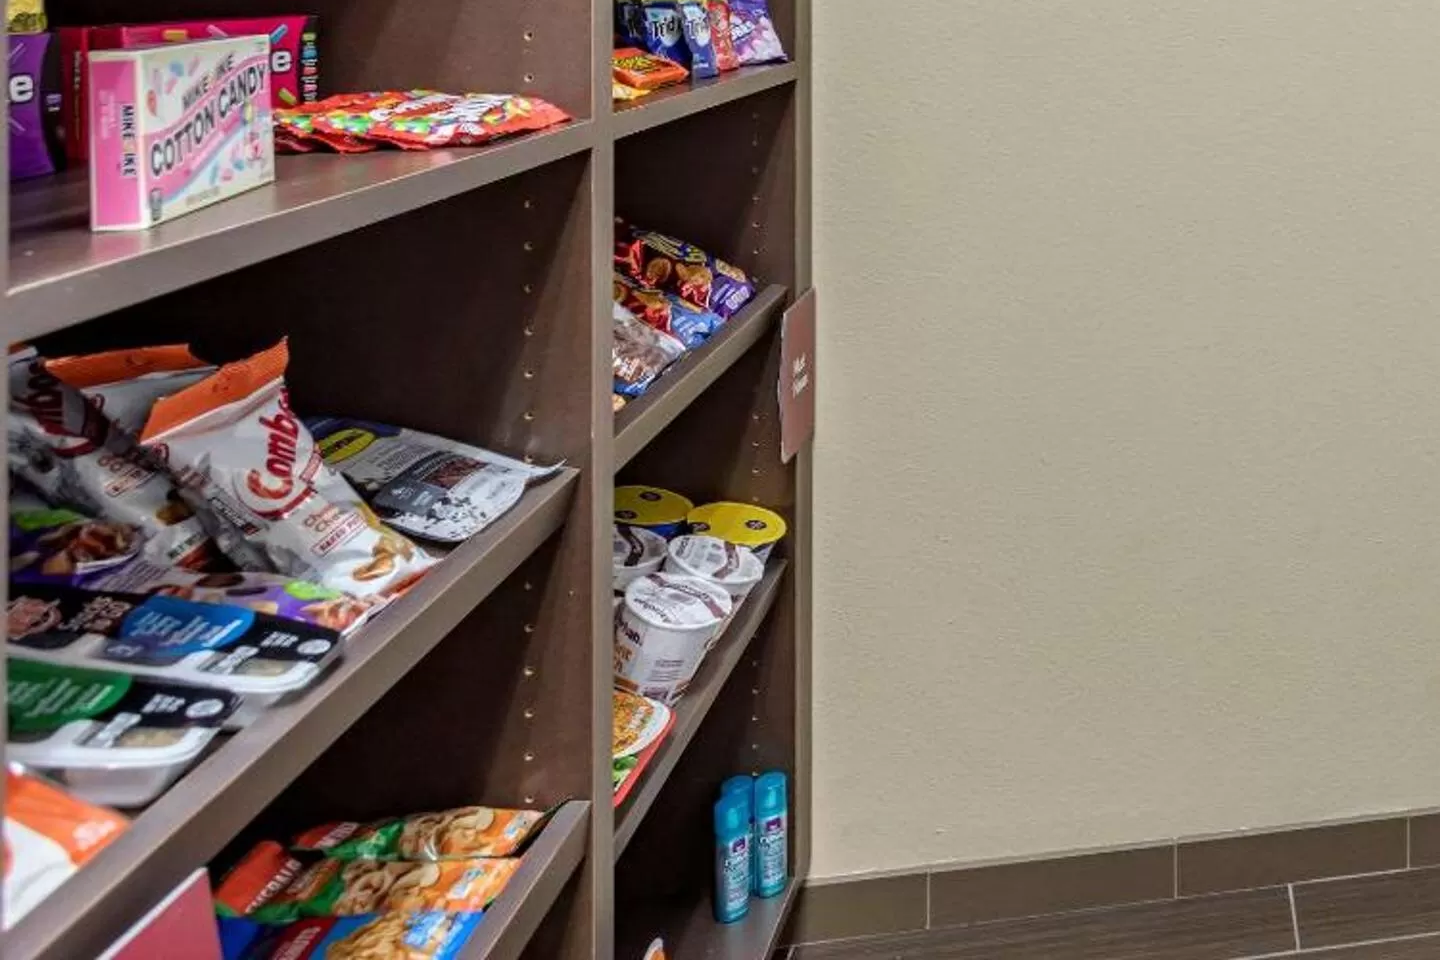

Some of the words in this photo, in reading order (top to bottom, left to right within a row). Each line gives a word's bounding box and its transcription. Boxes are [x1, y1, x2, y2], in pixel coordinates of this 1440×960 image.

[121, 104, 135, 140] MIKE
[150, 99, 218, 177] COTTON
[217, 62, 267, 120] CANDY
[122, 152, 137, 177] IKE
